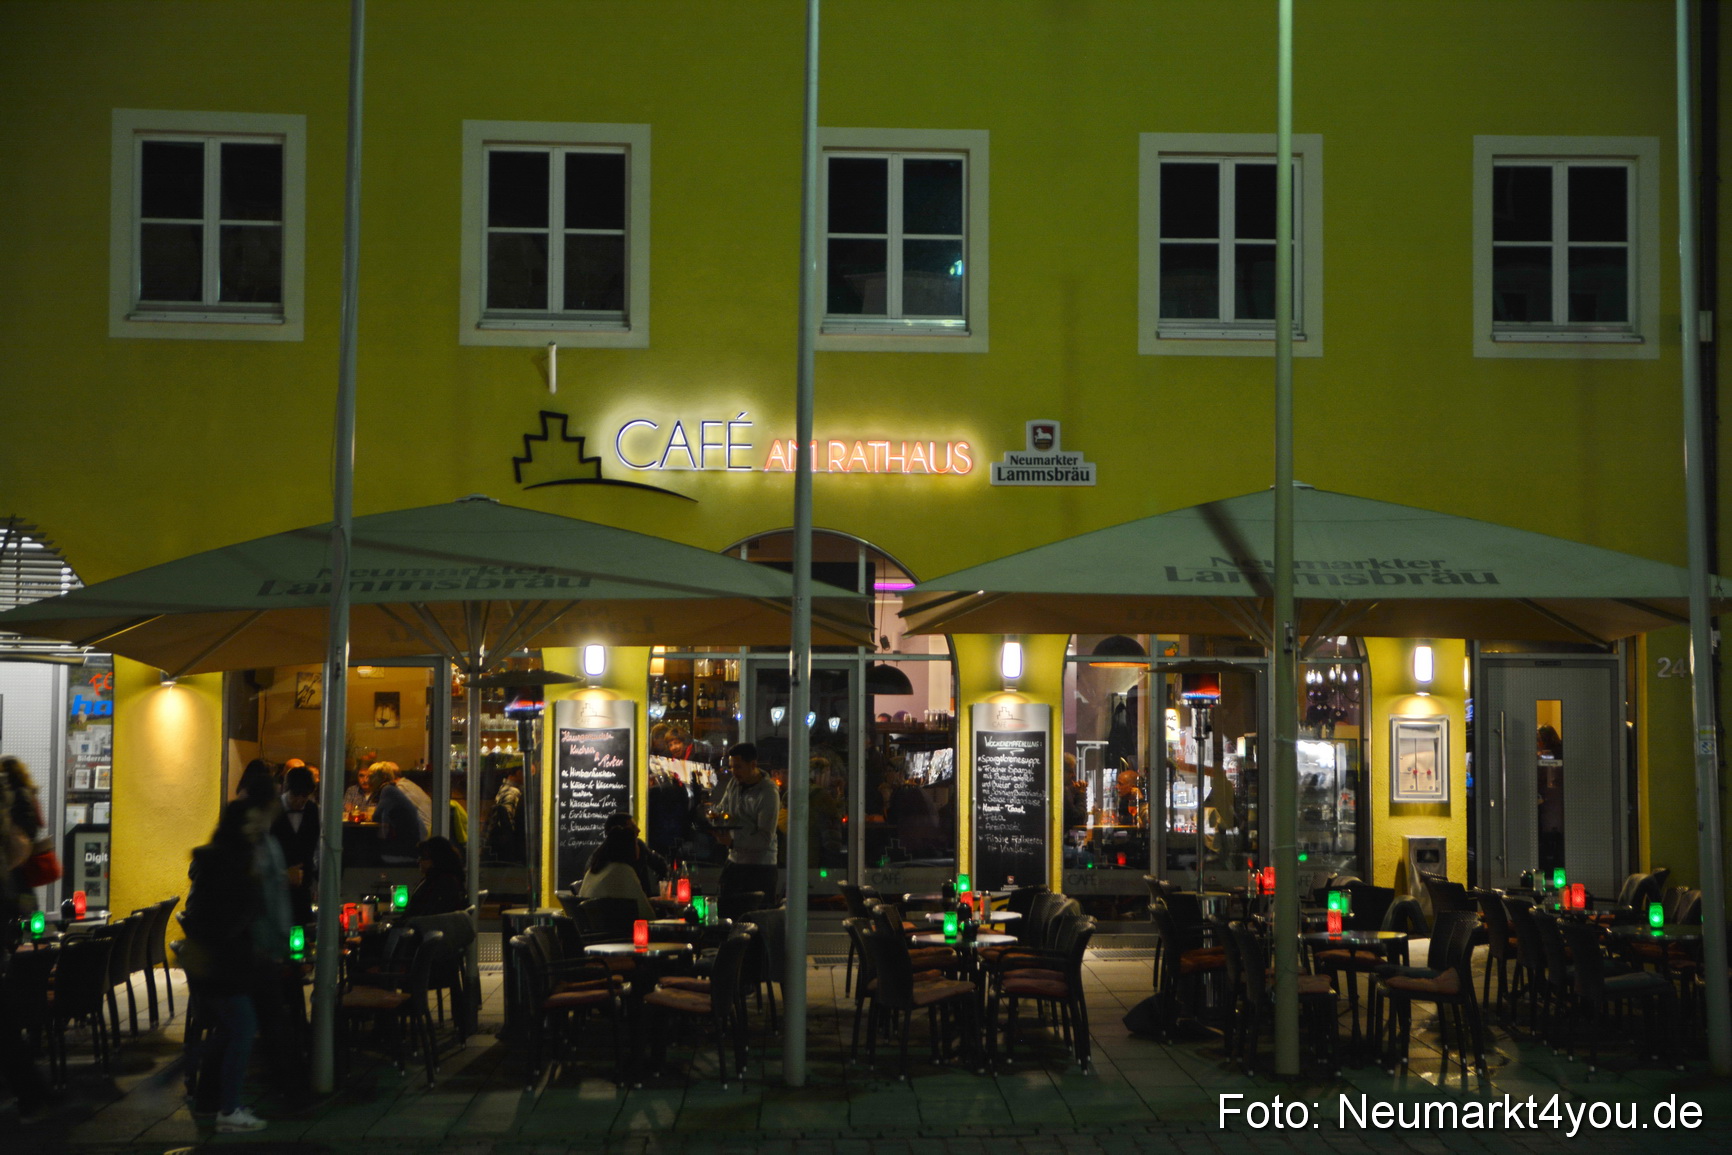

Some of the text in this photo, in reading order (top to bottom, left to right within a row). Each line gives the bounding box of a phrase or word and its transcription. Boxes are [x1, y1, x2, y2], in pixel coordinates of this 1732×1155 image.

[614, 411, 753, 471] CAFÉ
[828, 439, 973, 475] RATHAUS
[1010, 455, 1078, 466] Neumarkter
[997, 467, 1090, 482] Lammsbräu
[1656, 656, 1687, 679] 24
[85, 852, 109, 864] Digit
